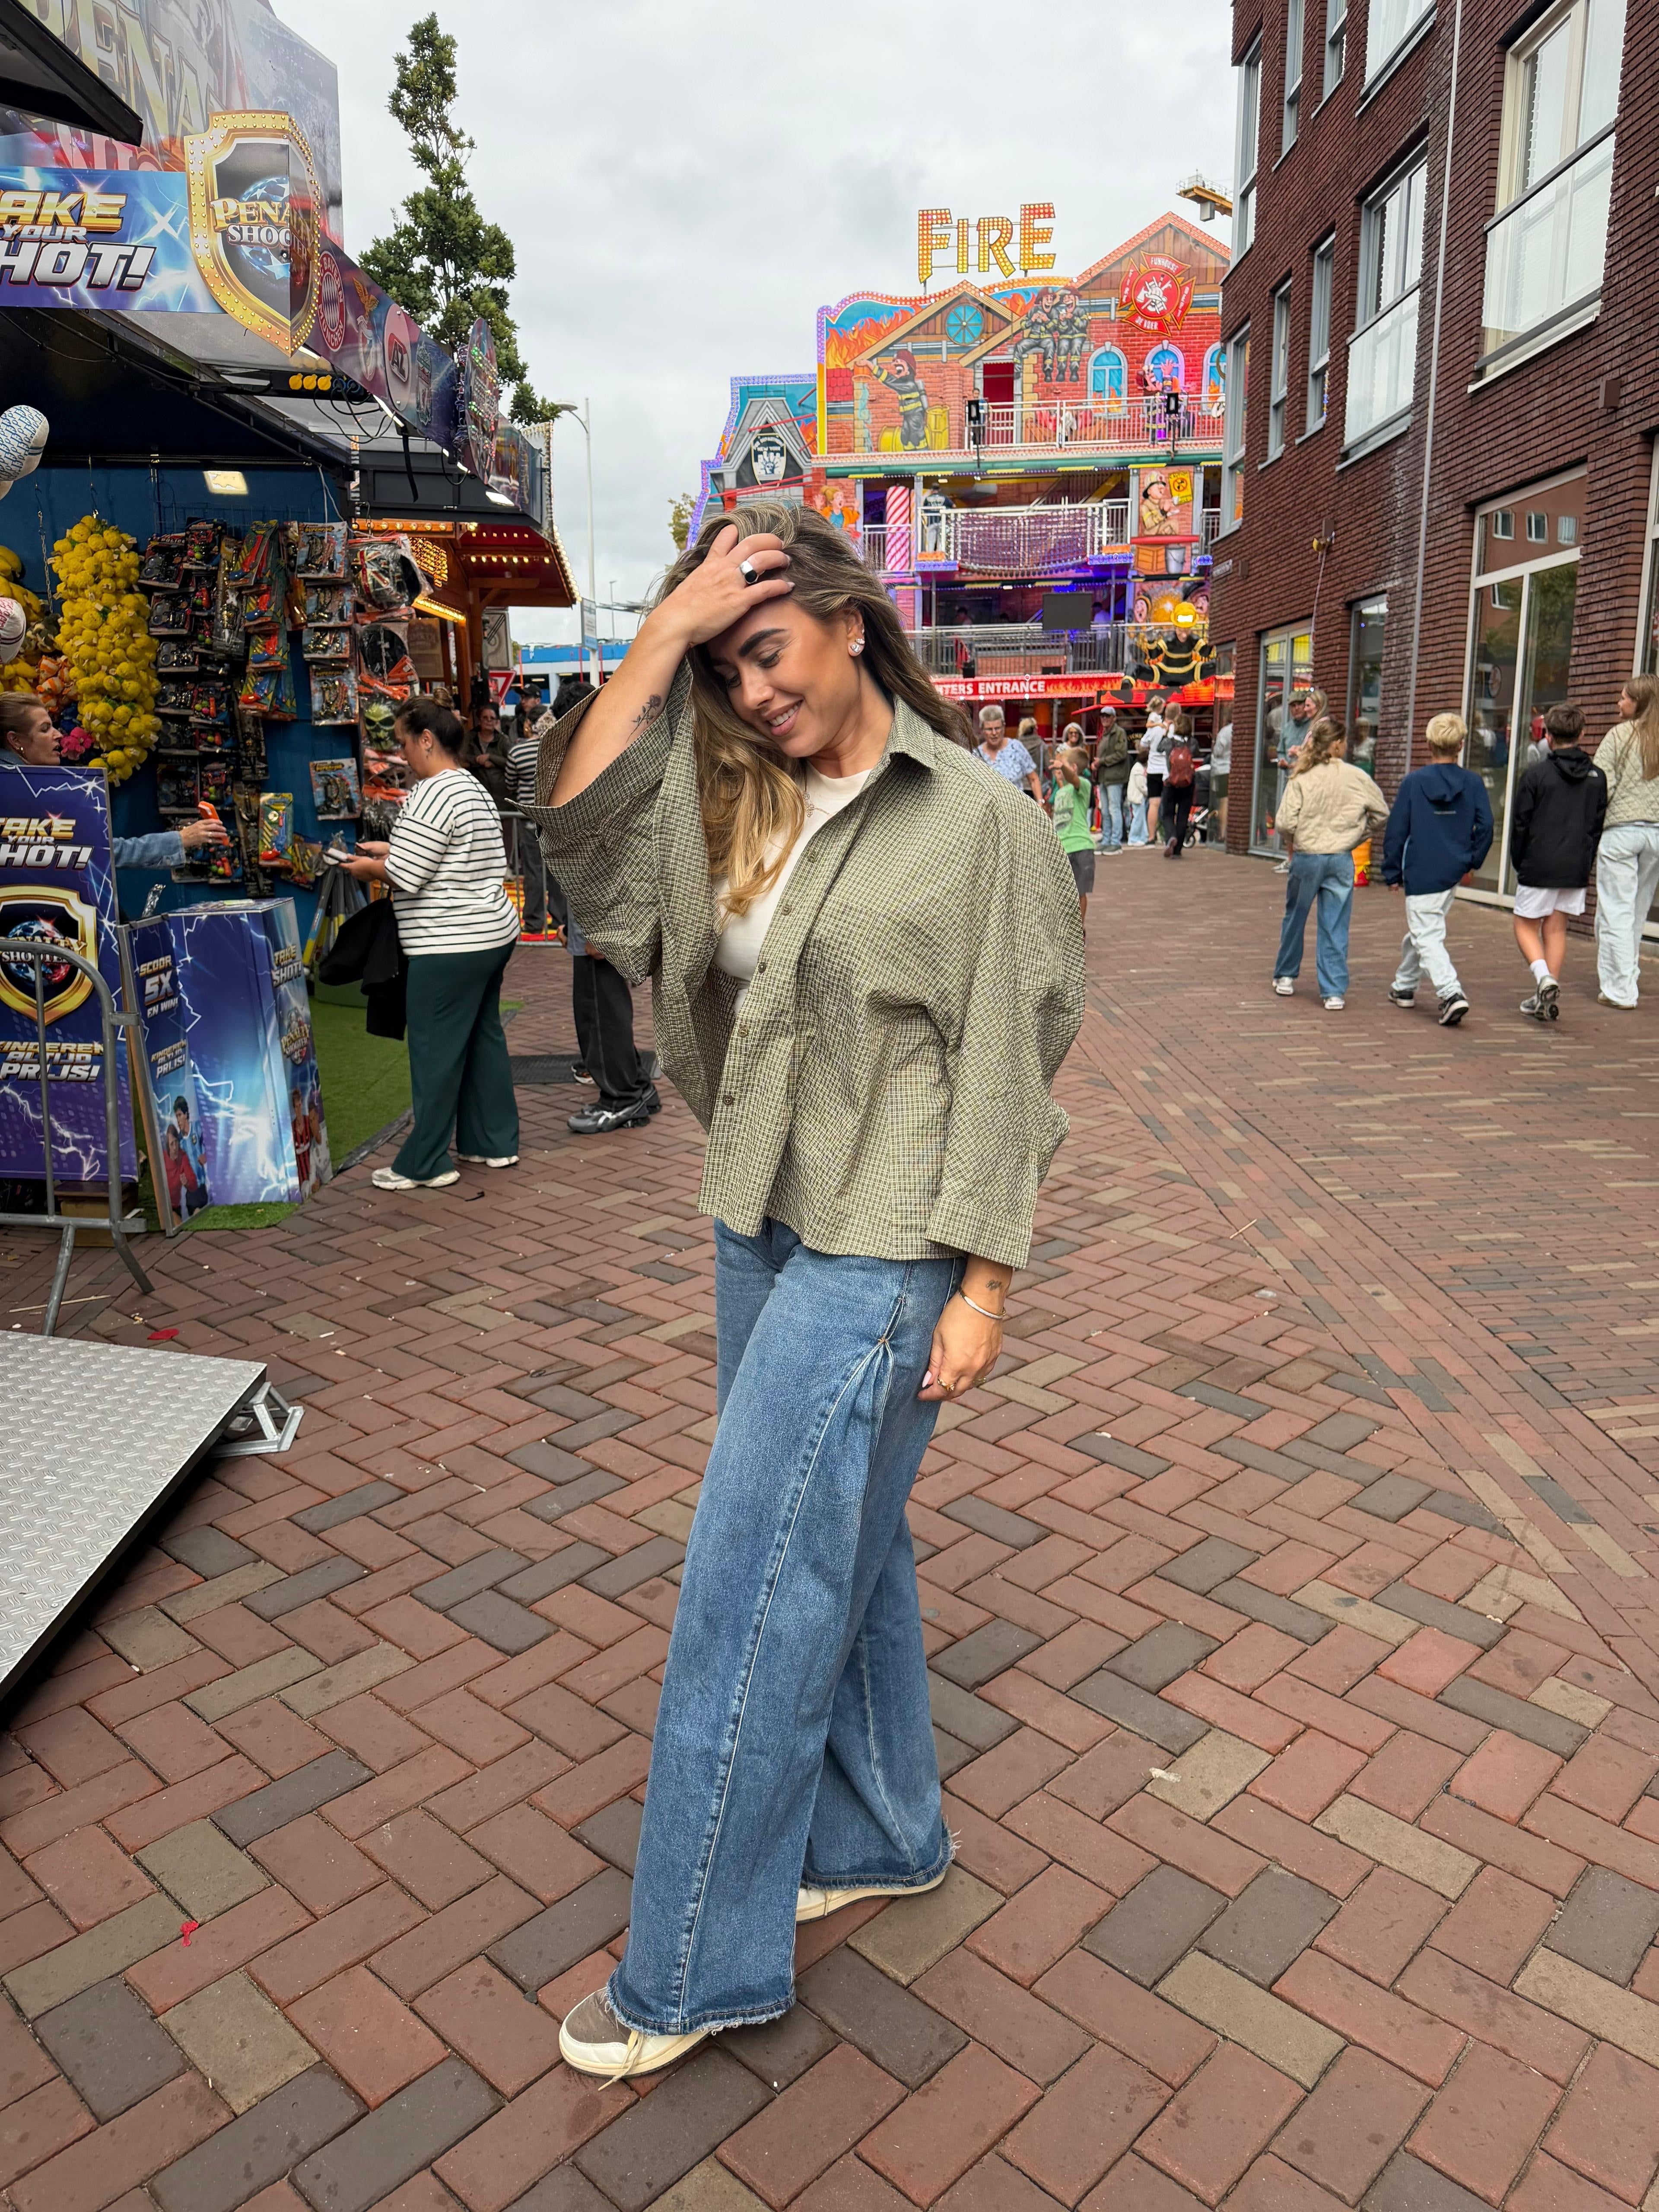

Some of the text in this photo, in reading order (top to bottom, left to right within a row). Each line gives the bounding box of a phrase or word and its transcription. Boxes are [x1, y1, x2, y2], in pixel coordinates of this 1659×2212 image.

[0, 191, 127, 232] AKE
[2, 224, 88, 243] YOUR
[918, 203, 1055, 283] FIRE
[1150, 257, 1179, 273] FUNHOUSE
[324, 257, 343, 302] BAYERN
[1122, 269, 1134, 302] FIRE
[978, 681, 1045, 694] ENTRANCE
[8, 836, 54, 845] YOUR
[139, 955, 172, 977] SCOOR
[274, 944, 296, 966] TAKE
[272, 961, 302, 988] SHOT!
[144, 970, 174, 1006] 5X
[147, 997, 178, 1018] EN WIN!
[0, 1062, 100, 1082] PRJS!
